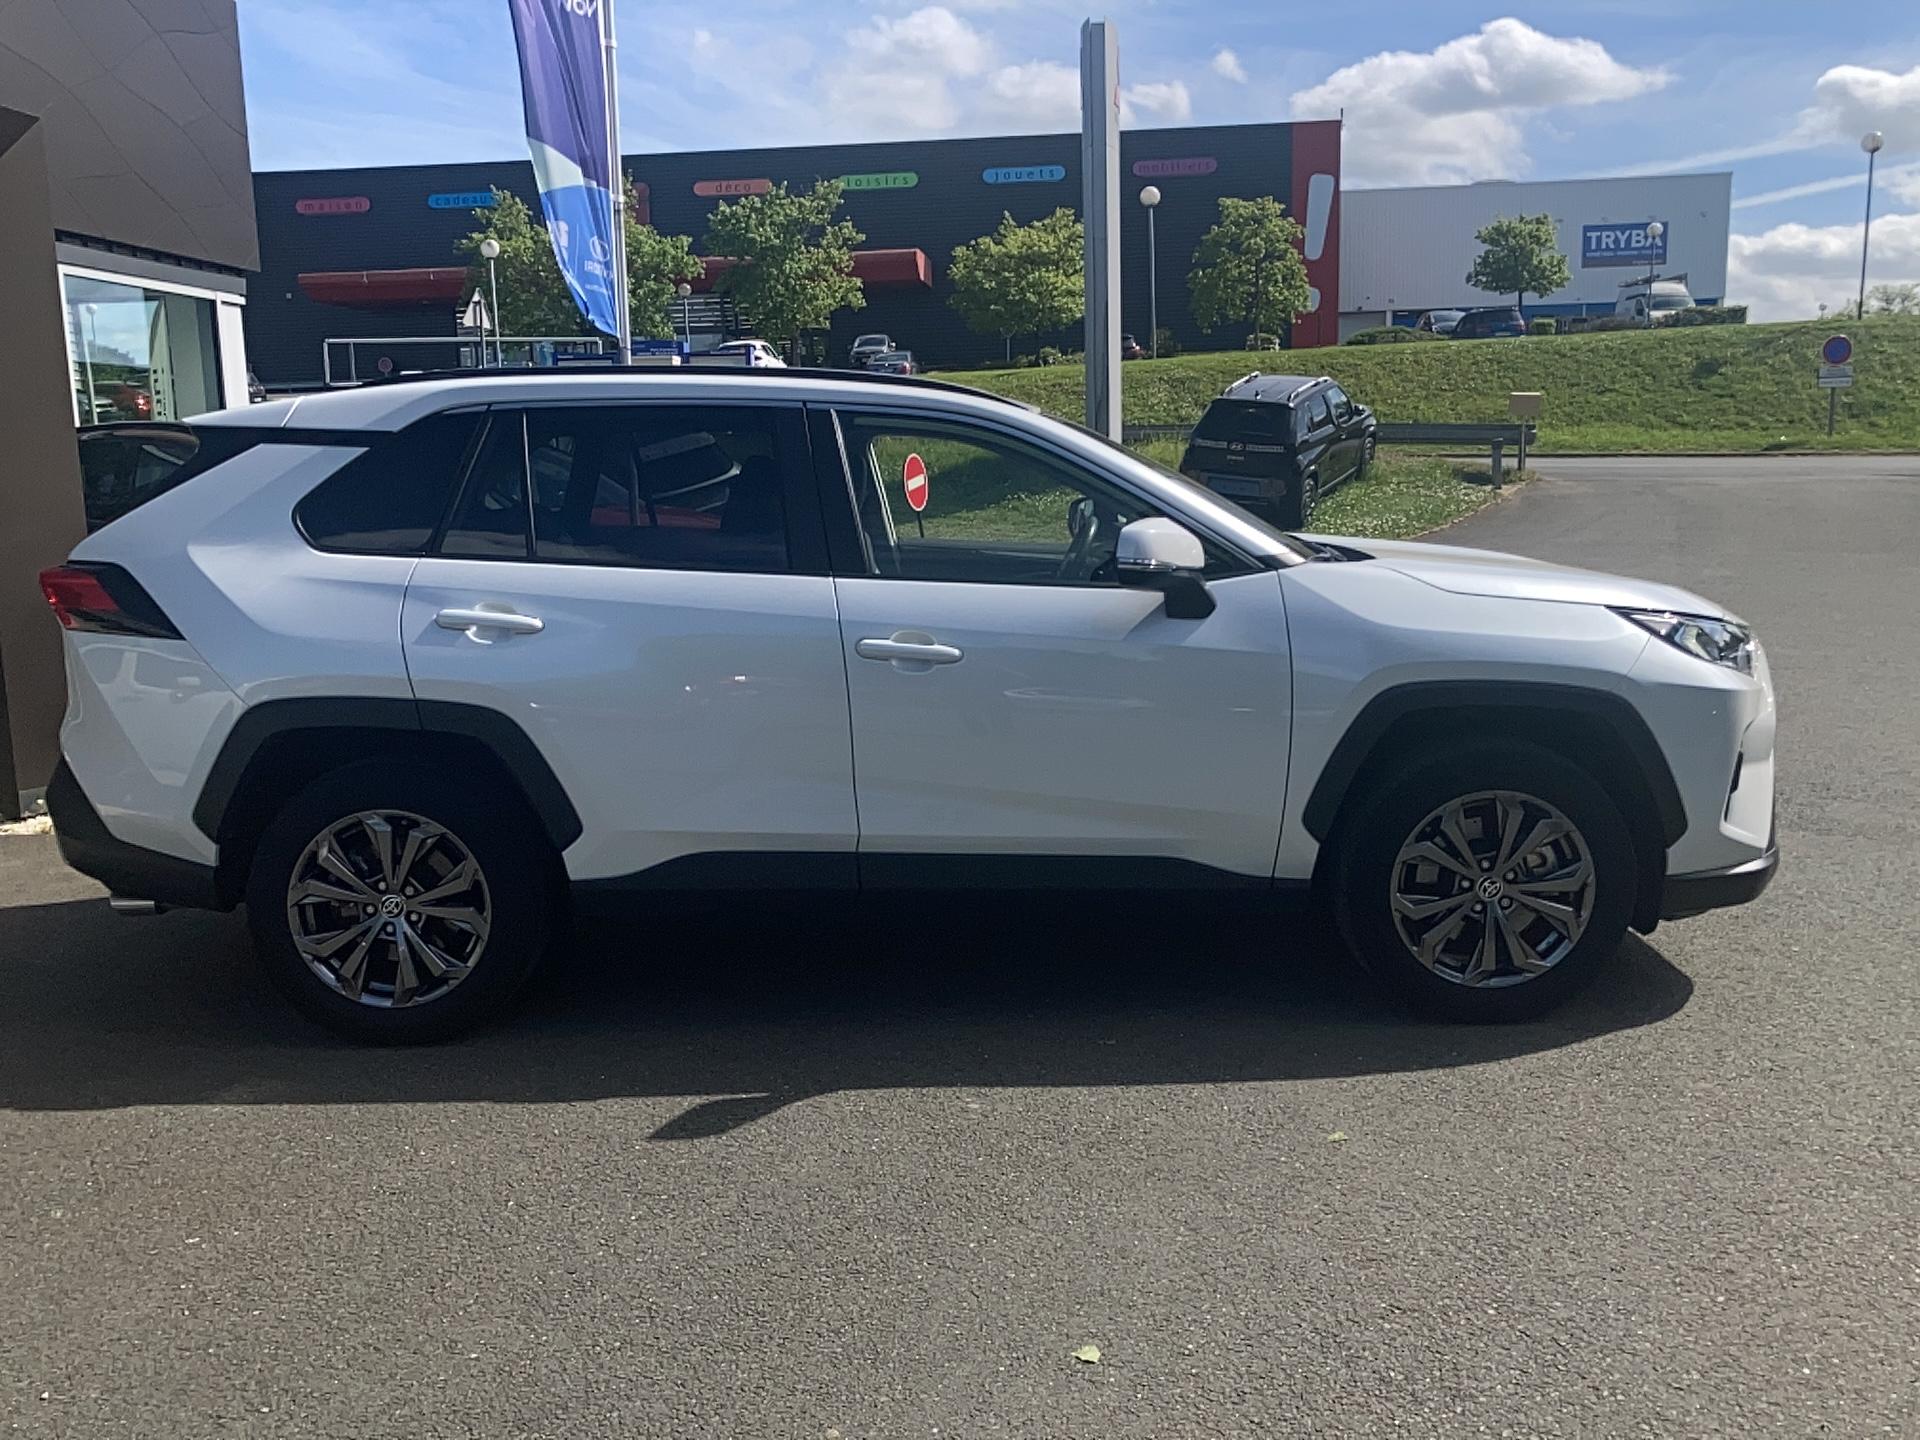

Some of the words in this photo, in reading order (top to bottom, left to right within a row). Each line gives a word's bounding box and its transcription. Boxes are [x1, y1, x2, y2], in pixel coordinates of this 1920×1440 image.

[994, 168, 1055, 182] jouets
[715, 181, 751, 193] déco
[846, 175, 909, 188] loisirs
[304, 200, 363, 212] maison
[435, 195, 495, 206] cadeau
[1586, 229, 1663, 250] TRYBA
